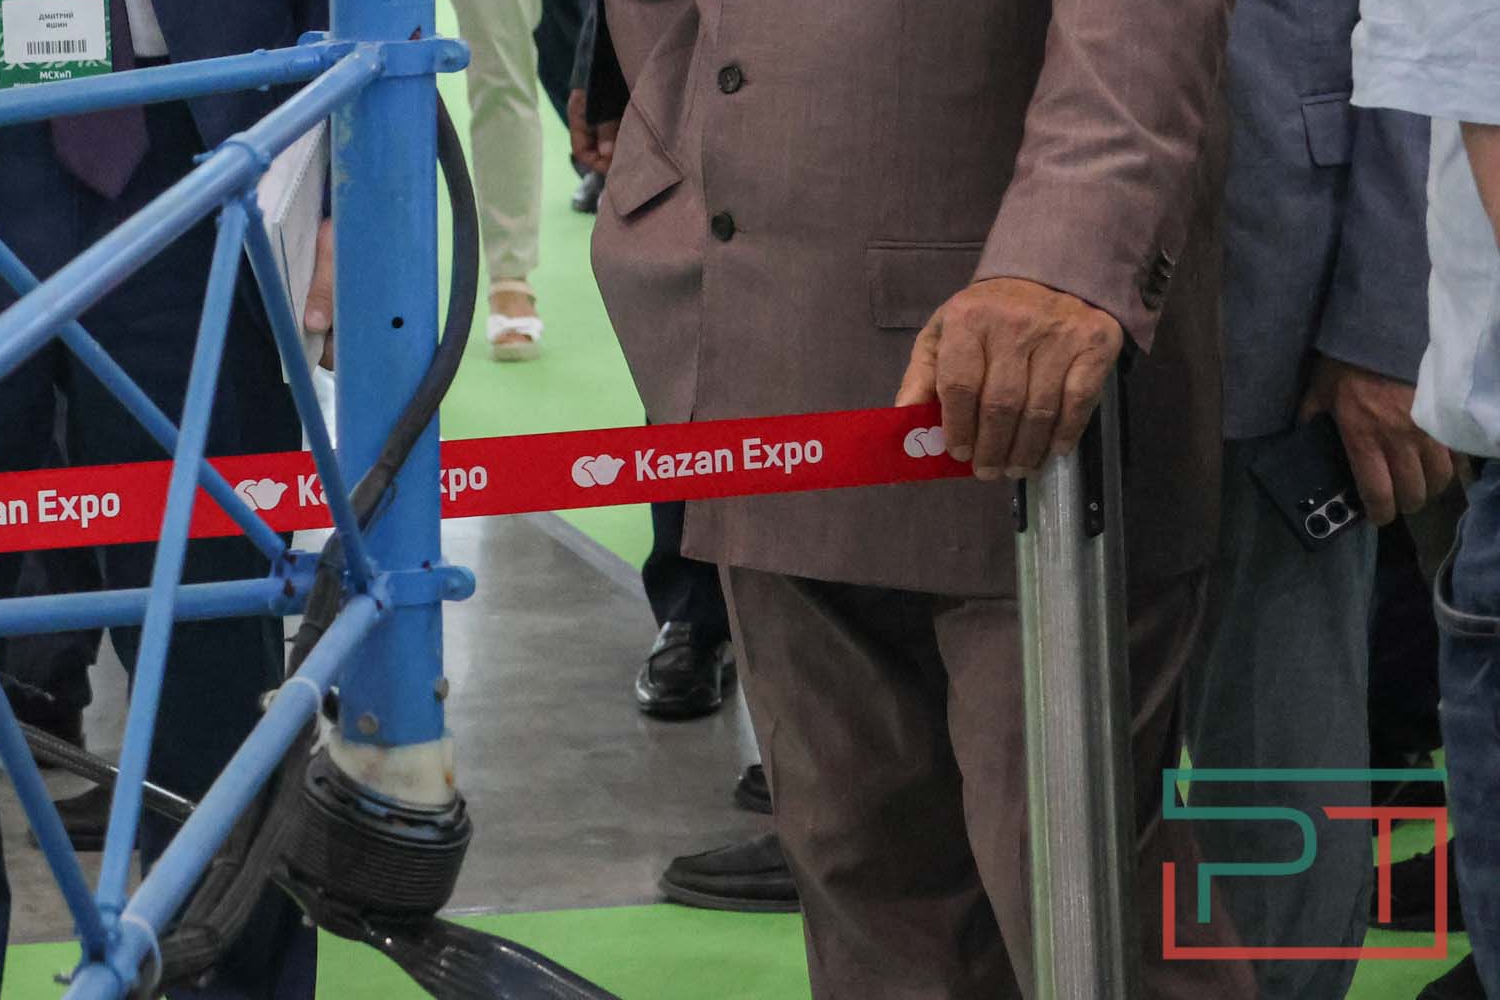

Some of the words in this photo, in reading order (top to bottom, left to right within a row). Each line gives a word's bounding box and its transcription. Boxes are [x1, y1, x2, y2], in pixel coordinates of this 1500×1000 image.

[38, 12, 74, 21] ДМИТРИЙ
[635, 446, 734, 482] Kazan
[744, 437, 824, 473] Expo
[38, 489, 121, 529] Expo
